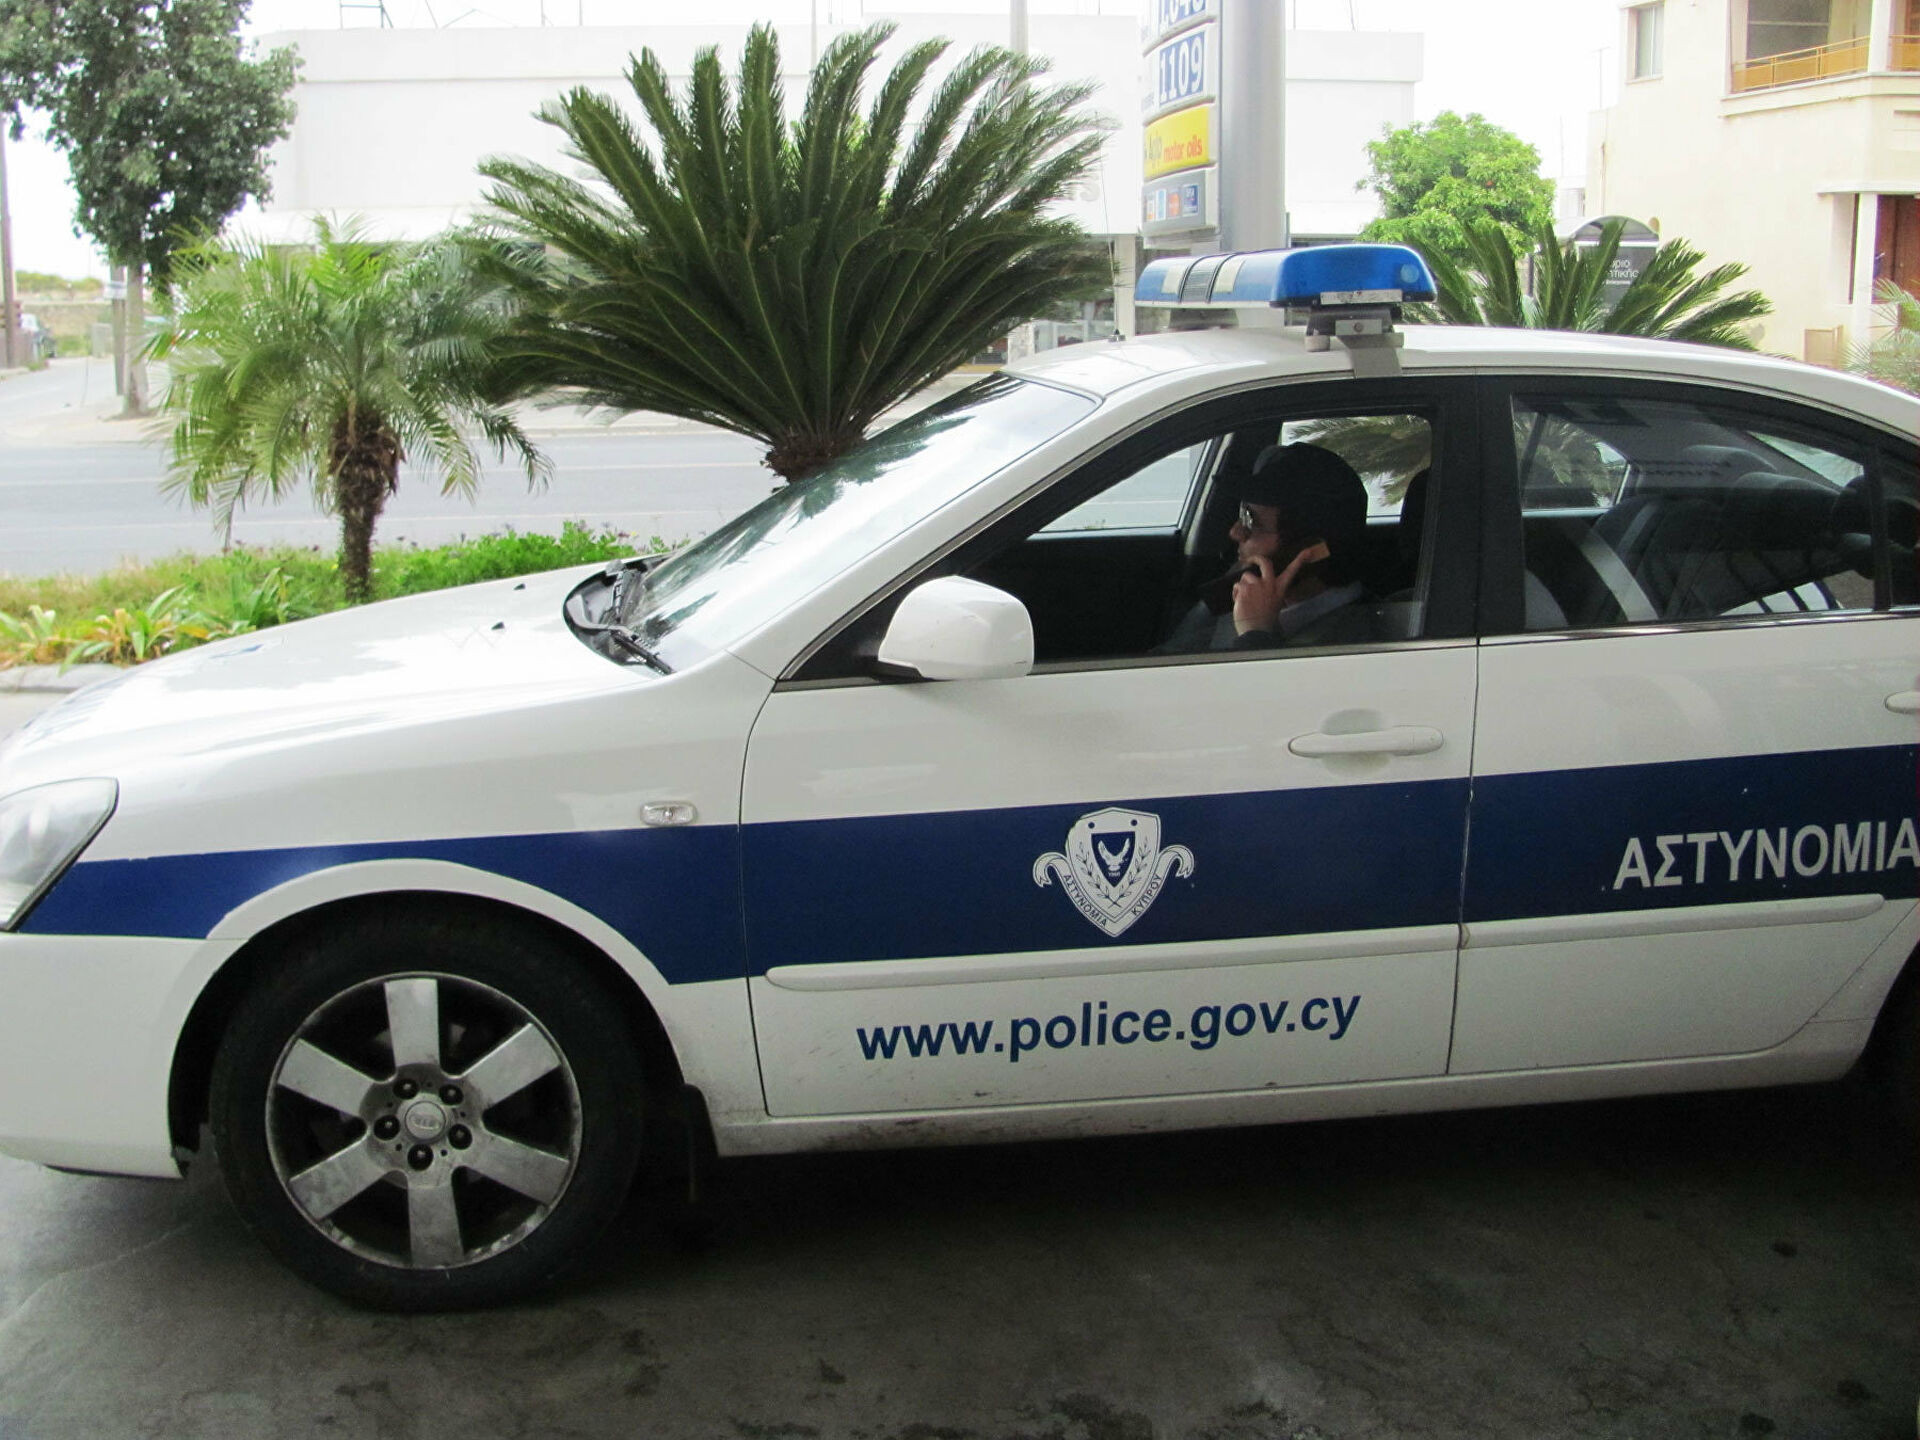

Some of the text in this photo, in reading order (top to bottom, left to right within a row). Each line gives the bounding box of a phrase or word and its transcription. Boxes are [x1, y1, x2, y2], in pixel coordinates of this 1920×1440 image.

[1161, 37, 1203, 101] 1109
[1613, 818, 1920, 890] ΑΣΤΥΝΟΜΙΑ
[1064, 874, 1162, 927] ΑΣΤΥΝΟΜΙΑ ΚΥΠΡΟΥ
[857, 995, 1361, 1062] www.police.gov.cy
